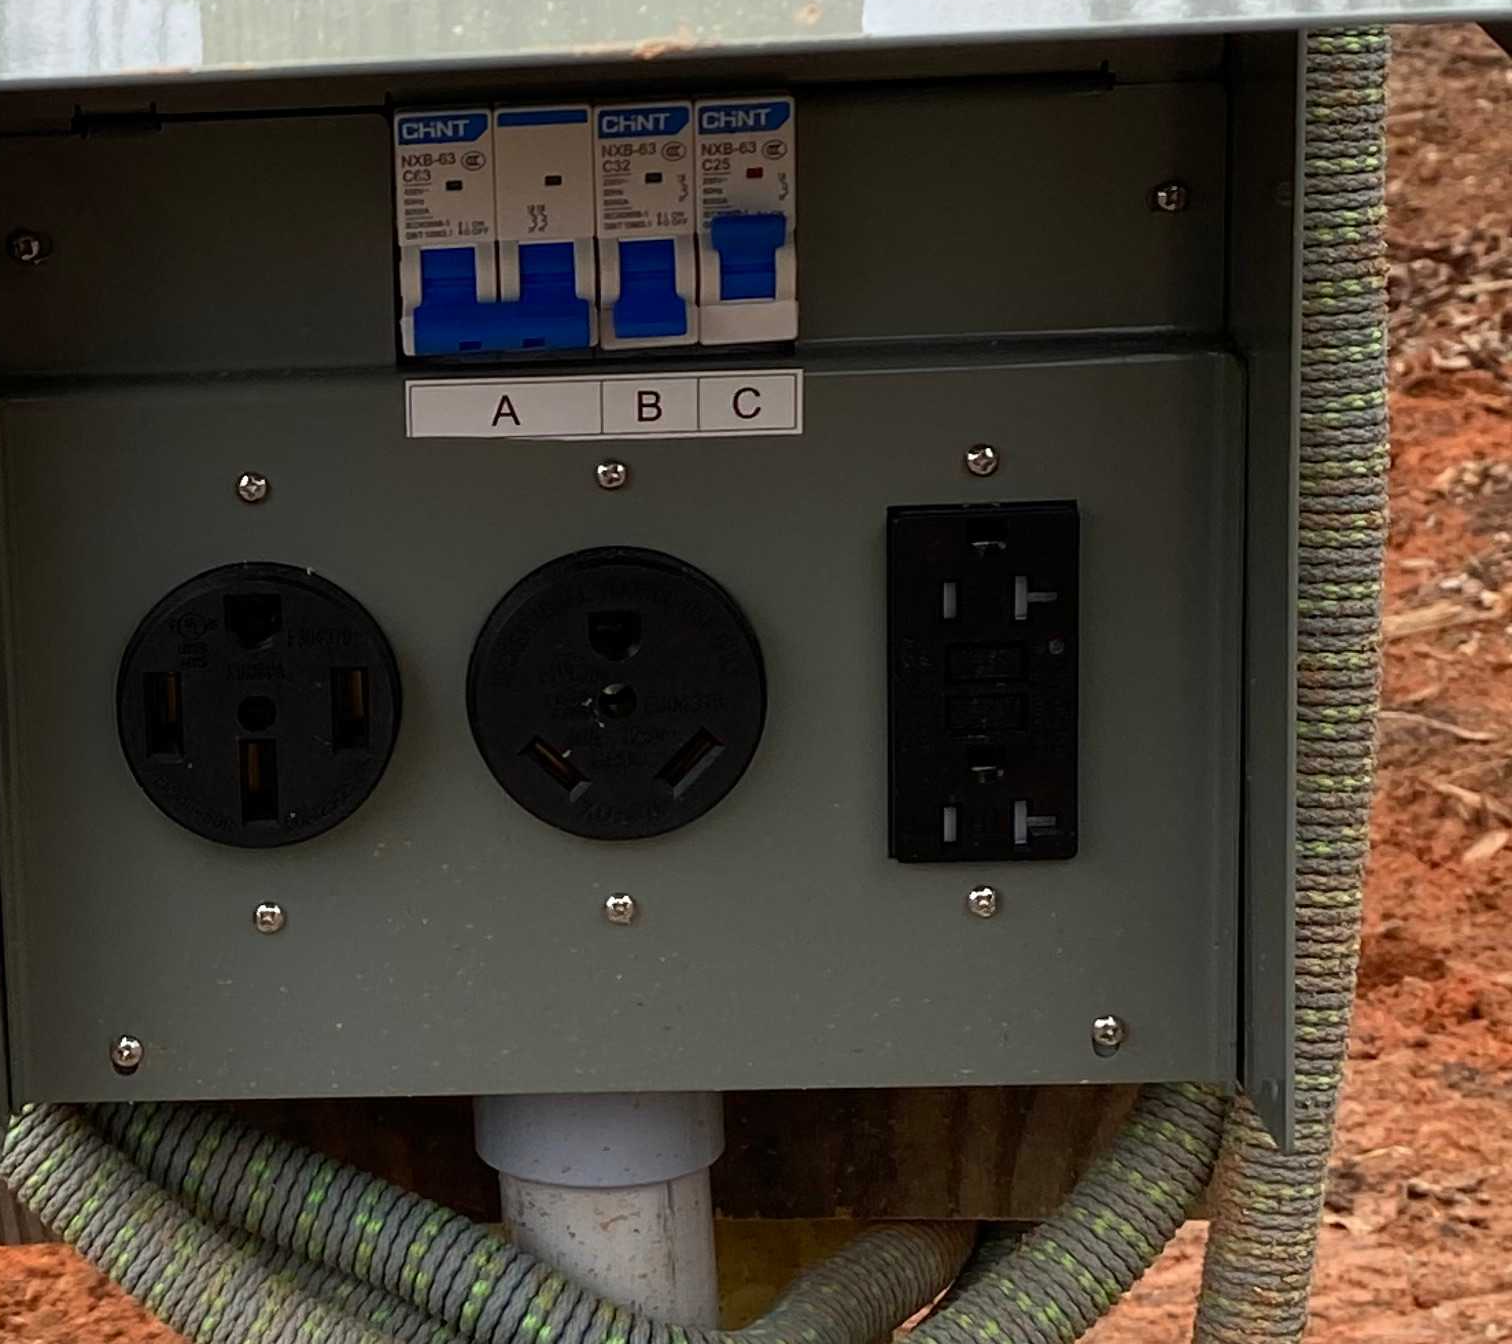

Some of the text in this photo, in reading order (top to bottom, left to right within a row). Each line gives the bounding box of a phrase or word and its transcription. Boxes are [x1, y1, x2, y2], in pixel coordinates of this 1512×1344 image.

[601, 142, 657, 158] NXB-63
[701, 141, 757, 157] NXB-63
[401, 152, 457, 169] NXB-63
[602, 159, 631, 173] C32
[702, 157, 731, 172] C25
[402, 169, 432, 184] C63
[491, 387, 762, 427] A B C
